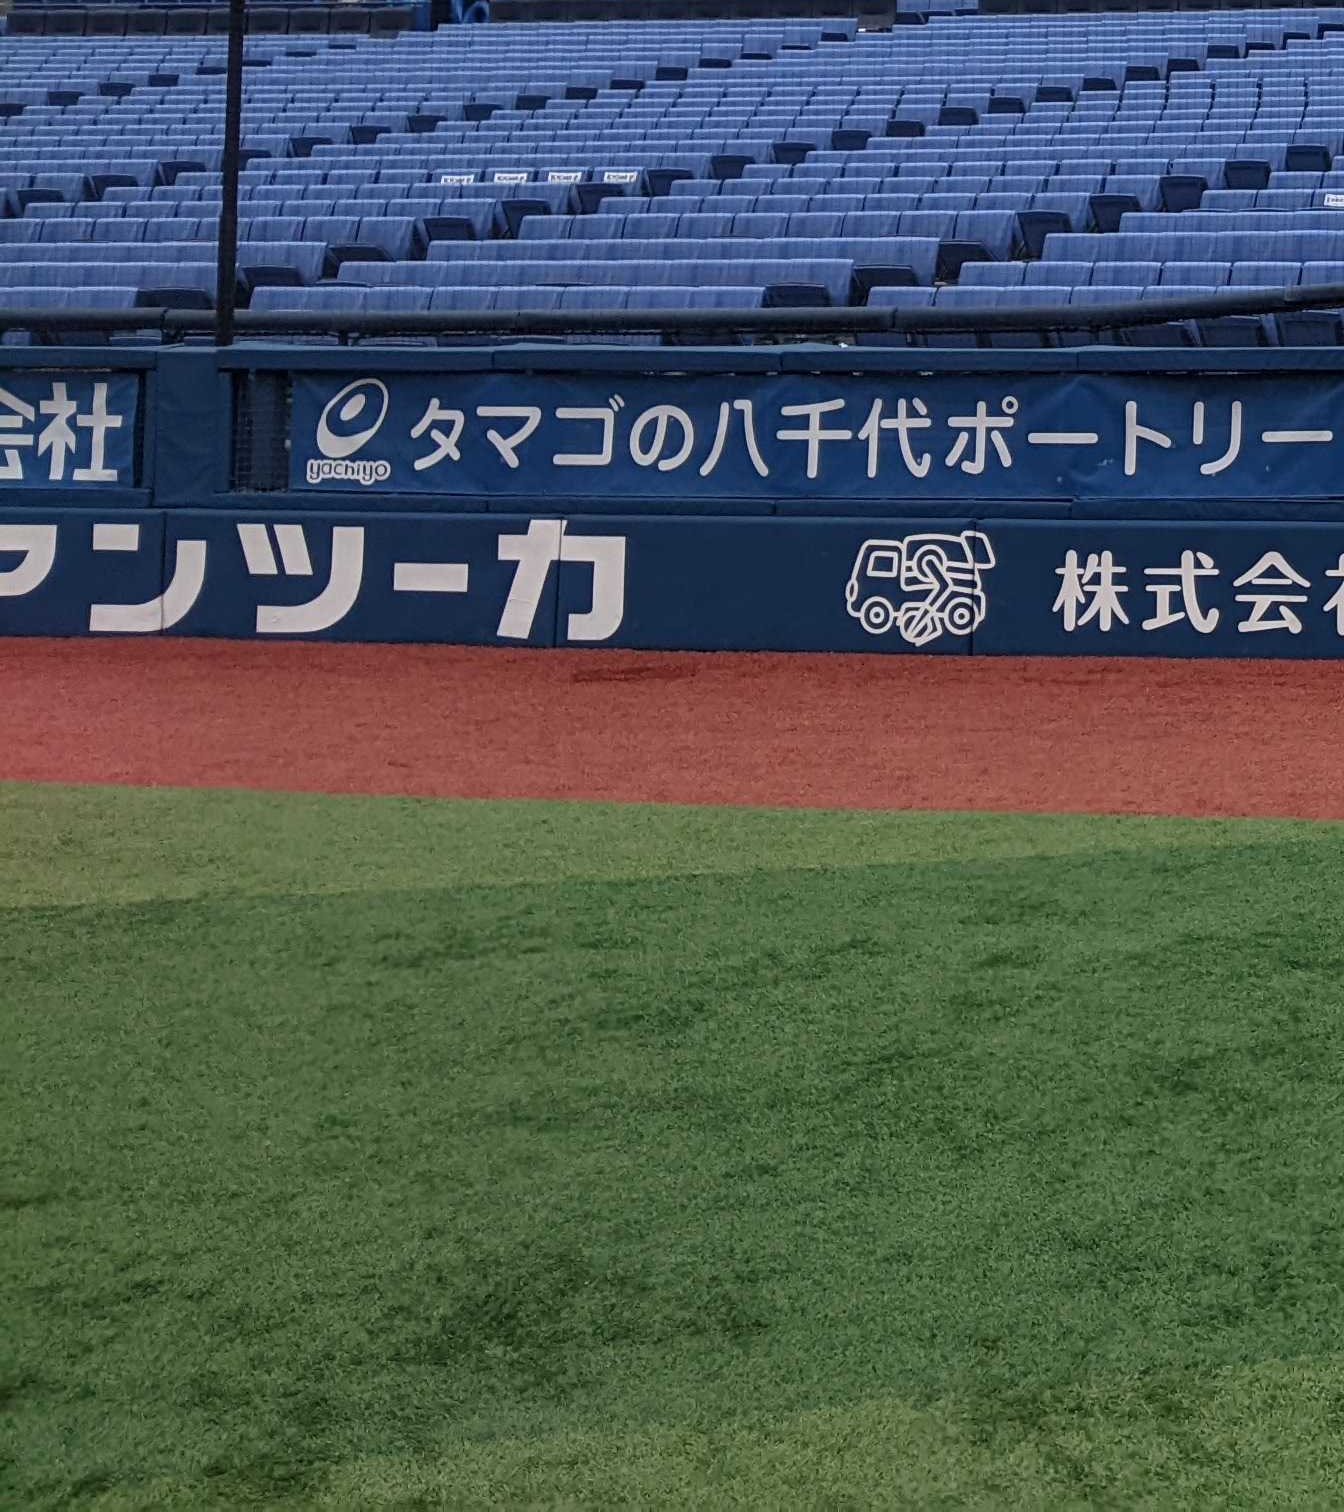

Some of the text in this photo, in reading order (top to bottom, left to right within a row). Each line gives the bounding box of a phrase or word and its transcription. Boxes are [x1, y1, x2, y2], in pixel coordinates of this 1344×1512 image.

[409, 393, 1335, 480] タマゴの八千代ポートリー
[306, 458, 392, 486] yachiyo
